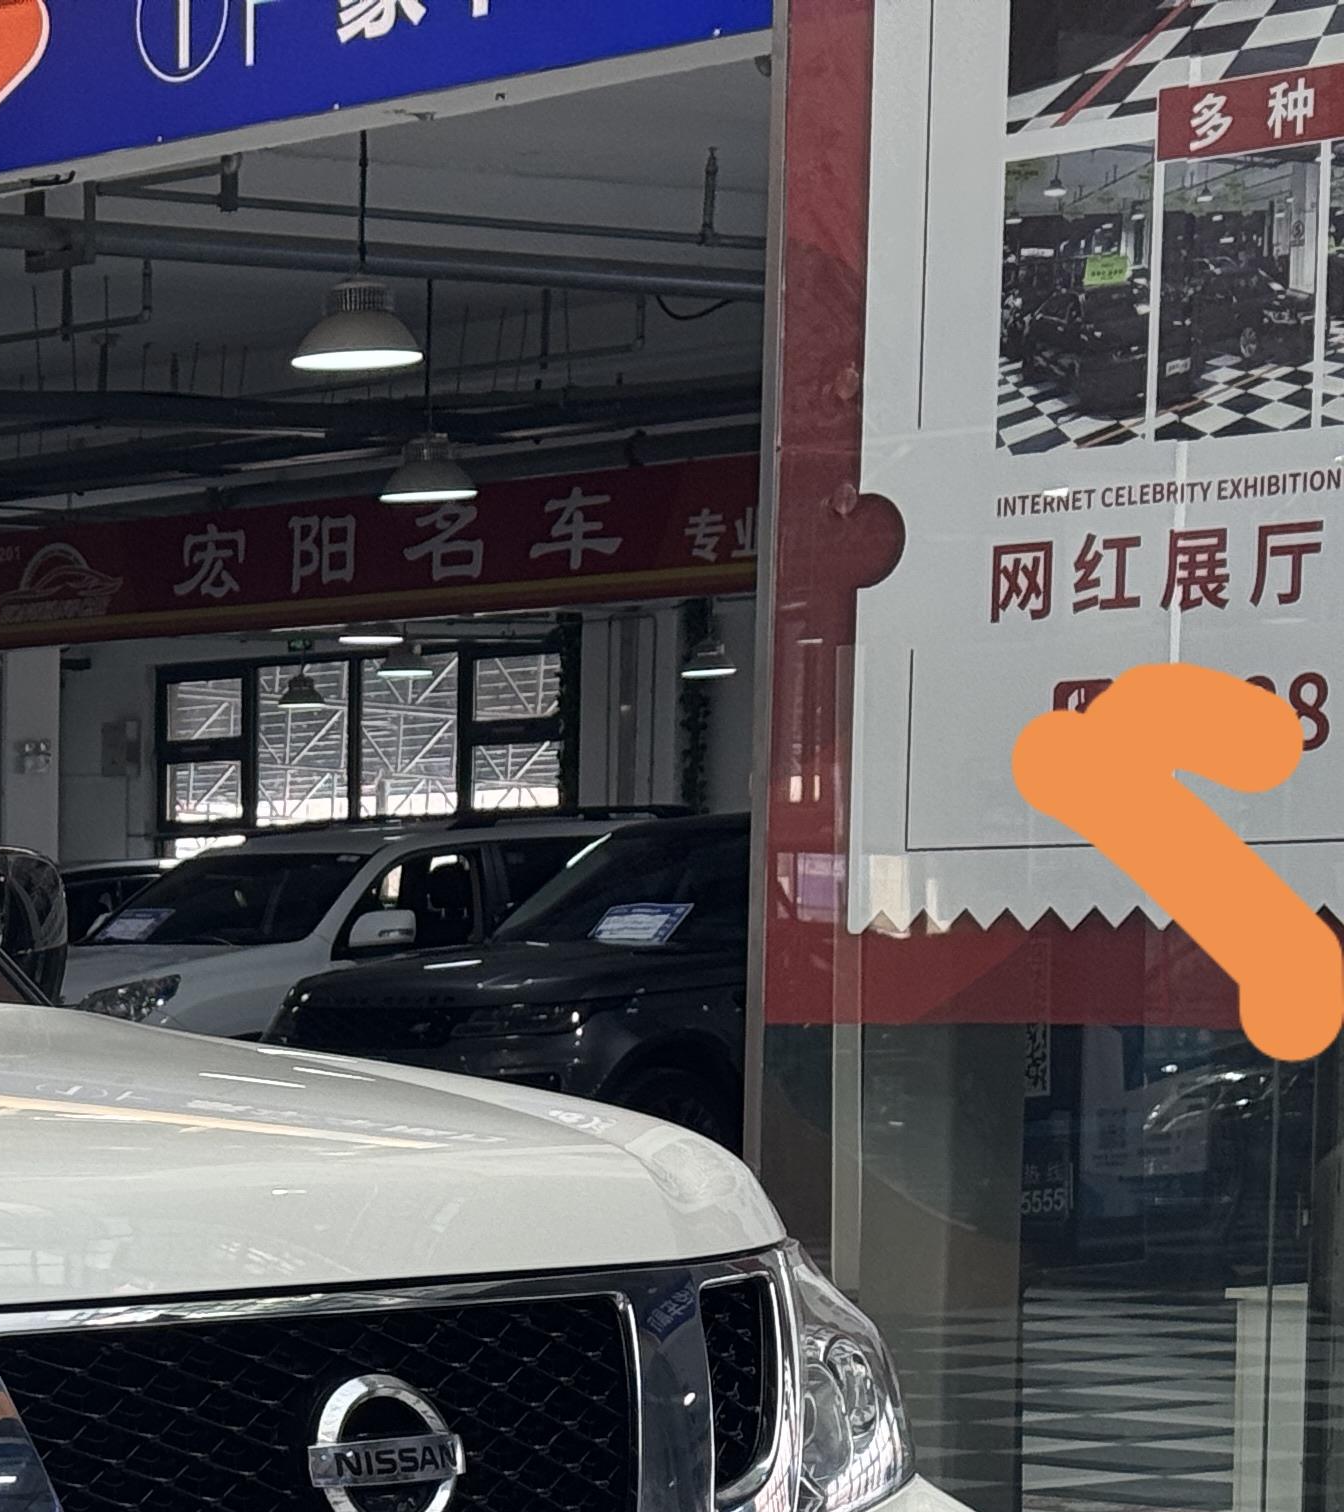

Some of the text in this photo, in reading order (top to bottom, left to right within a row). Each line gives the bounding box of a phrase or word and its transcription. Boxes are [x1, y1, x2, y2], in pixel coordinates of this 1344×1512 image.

[1189, 76, 1315, 152] 多种
[996, 467, 1342, 518] INTERNET CELEBRITY EXHIBITION
[173, 486, 623, 598] 宏阳名车
[990, 520, 1324, 624] 网红展厅
[334, 1442, 458, 1478] NISSAN
